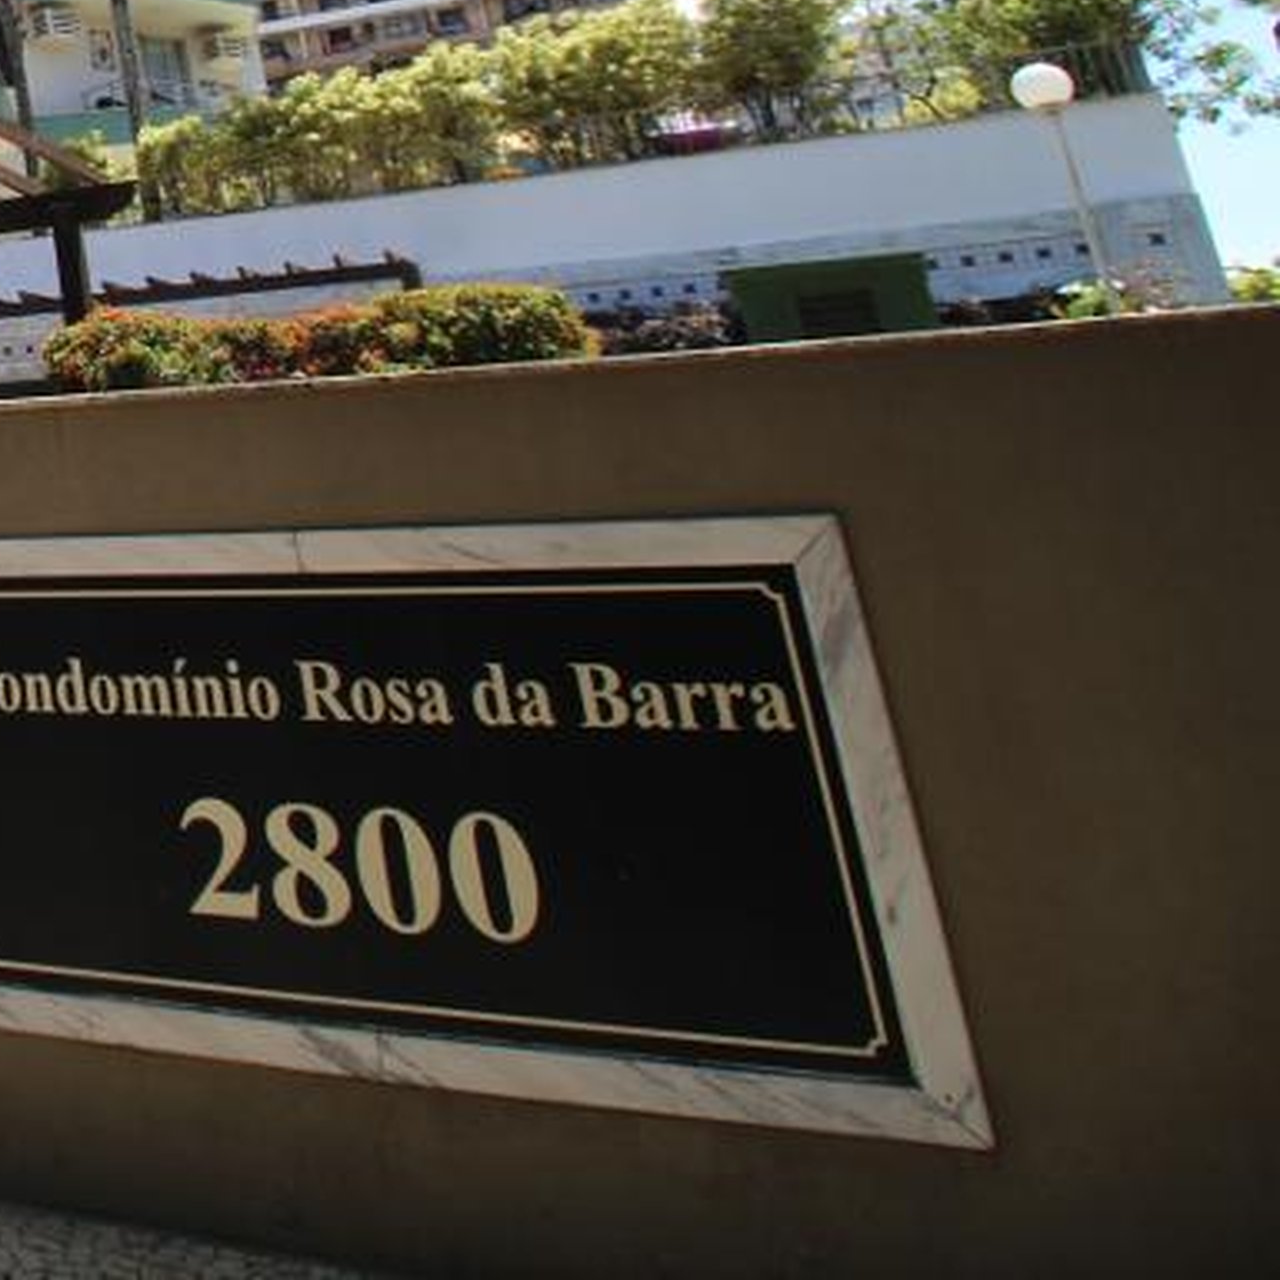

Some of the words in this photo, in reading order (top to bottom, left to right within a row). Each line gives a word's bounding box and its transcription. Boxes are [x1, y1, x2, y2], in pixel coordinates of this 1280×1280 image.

[293, 660, 455, 726] Rosa
[472, 661, 556, 728] da
[568, 662, 797, 733] Barra
[179, 796, 541, 944] 2800
